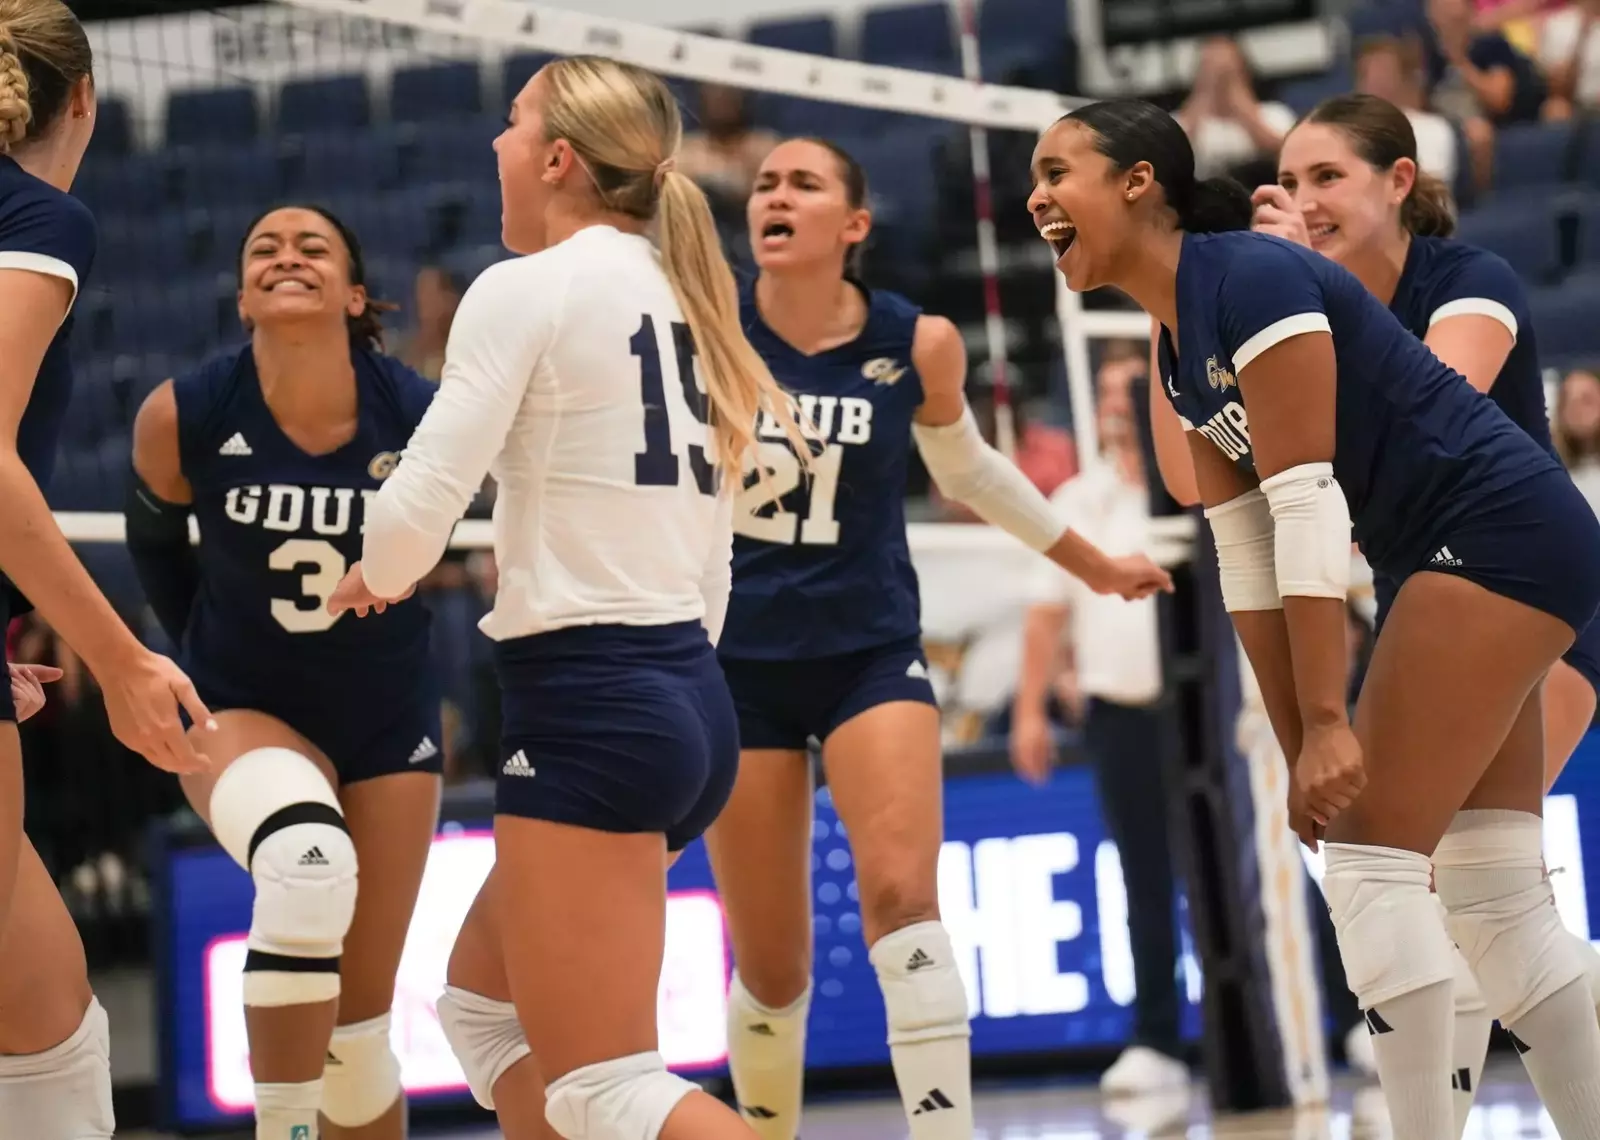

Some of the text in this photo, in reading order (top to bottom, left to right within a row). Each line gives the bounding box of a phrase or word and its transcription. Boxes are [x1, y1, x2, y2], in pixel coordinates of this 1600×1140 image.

[757, 394, 873, 445] DUB
[225, 484, 378, 536] GDU
[733, 443, 844, 544] 21
[268, 538, 346, 634] 3
[937, 831, 1090, 1020] HE
